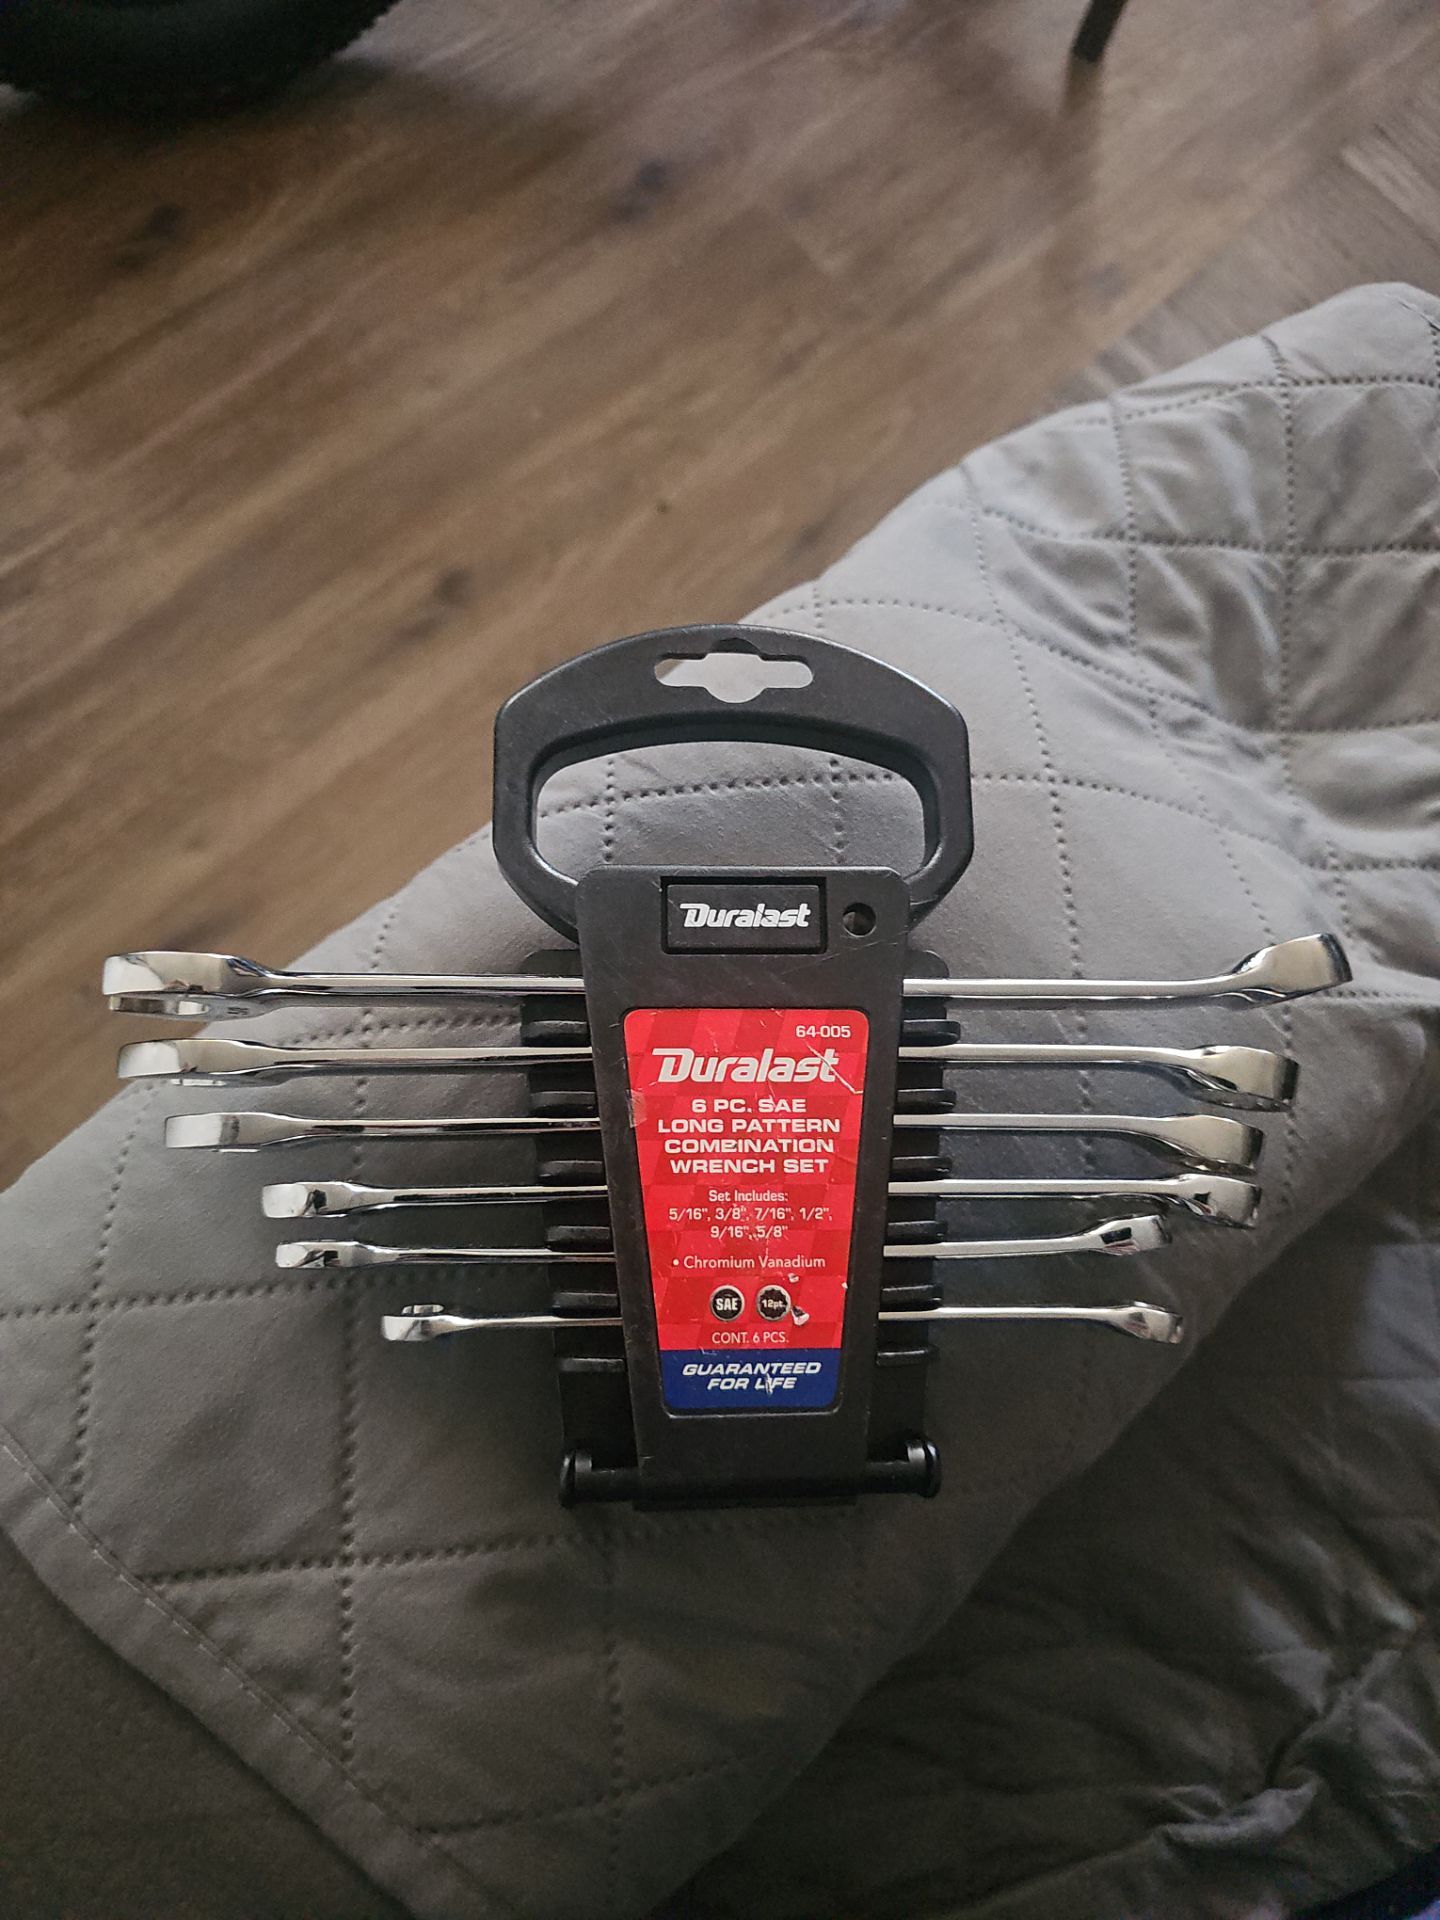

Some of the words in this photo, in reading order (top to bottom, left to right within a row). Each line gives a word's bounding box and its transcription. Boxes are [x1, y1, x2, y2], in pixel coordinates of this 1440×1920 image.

[680, 903, 811, 927] Duralast
[796, 1026, 851, 1038] 64-005
[652, 1048, 840, 1082] Duralast
[691, 1099, 706, 1112] 6
[713, 1099, 752, 1112] PC.
[758, 1099, 806, 1112] SAE
[658, 1119, 724, 1133] LONG
[732, 1119, 840, 1133] PATTERN
[664, 1139, 834, 1153] COMBINATION
[670, 1159, 775, 1173] WRENCH
[783, 1159, 829, 1173] SET
[709, 1190, 730, 1202] Set
[734, 1190, 788, 1202] Includes:
[684, 1256, 755, 1268] Chromium
[759, 1255, 826, 1268] Vanadium
[715, 1298, 739, 1311] SAE
[712, 1332, 749, 1344] CONT.
[753, 1332, 760, 1343] 6
[763, 1331, 789, 1343] PCS.
[682, 1362, 822, 1376] GUARANTEED
[707, 1378, 749, 1390] FOR
